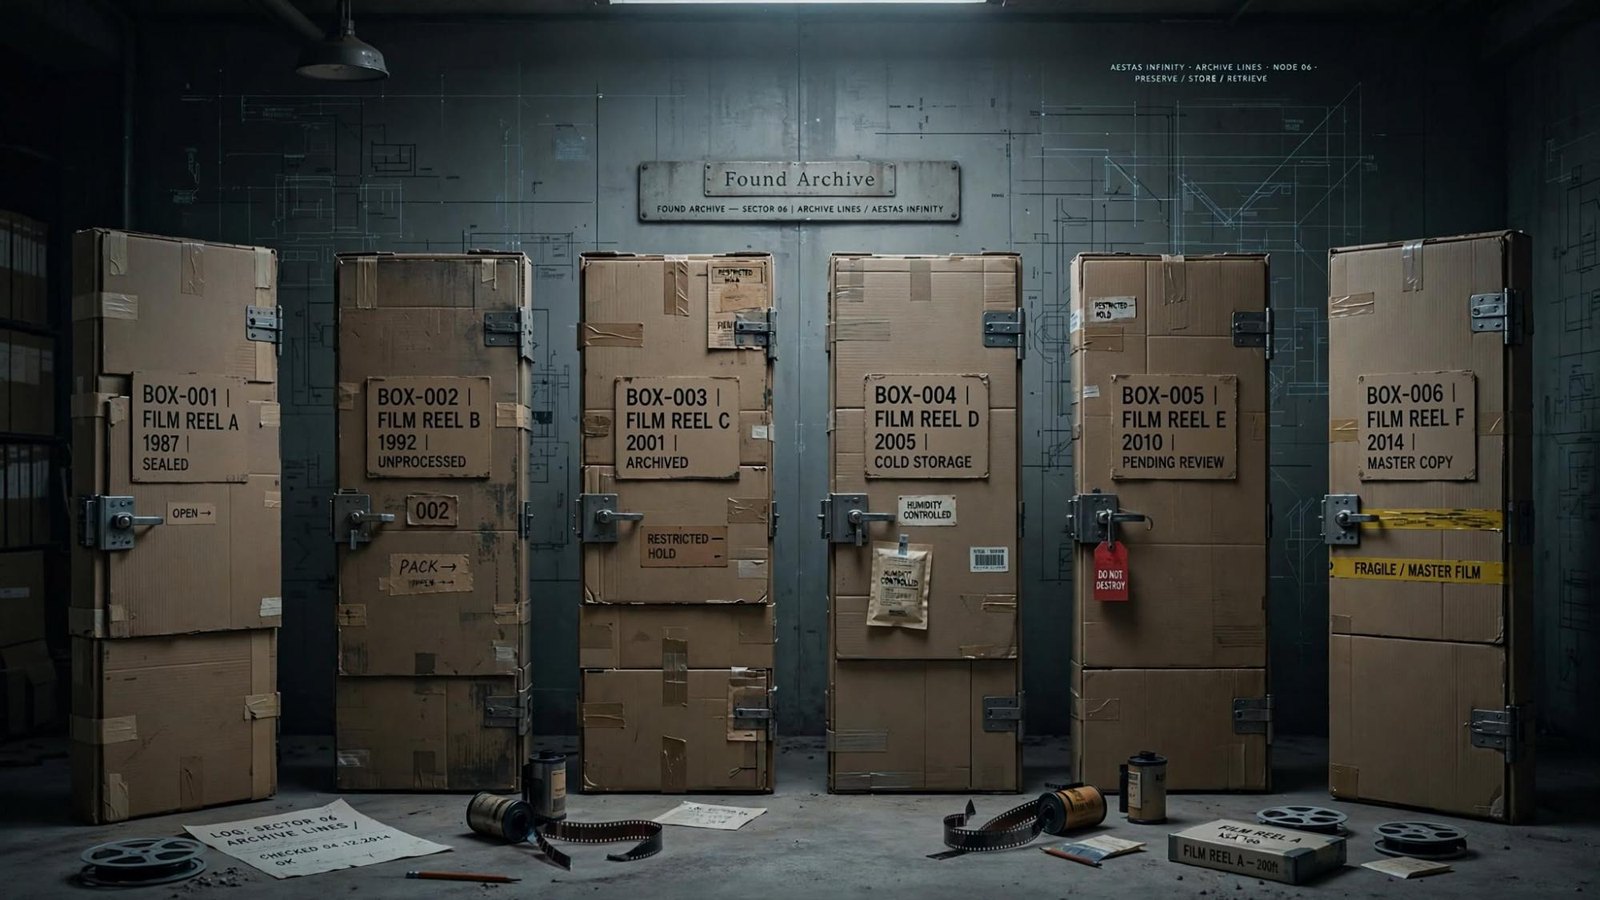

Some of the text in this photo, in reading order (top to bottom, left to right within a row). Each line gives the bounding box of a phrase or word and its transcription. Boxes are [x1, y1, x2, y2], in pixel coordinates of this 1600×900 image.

[725, 172, 875, 187] Found Archive
[657, 205, 687, 213] FOUND
[690, 205, 725, 213] ARCHIVE
[742, 205, 775, 213] SECTOR
[778, 205, 788, 213] 06
[798, 205, 834, 213] ARCHIVE
[837, 205, 861, 213] LINES
[872, 205, 903, 213] AESTAS
[906, 205, 944, 213] INFINITY
[143, 384, 217, 406] BOX-001
[378, 388, 458, 406] BOX-002
[626, 388, 707, 406] BOX-003
[875, 386, 956, 404] BOX-004
[1122, 386, 1204, 405] BOX-005
[1367, 384, 1443, 404] BOX-006
[143, 410, 239, 430] FILM REEL A
[378, 412, 480, 428] FILM REEL B
[626, 412, 730, 429] FILM REEL C
[875, 410, 979, 427] FILM REEL D
[1122, 410, 1226, 428] FILM REEL E
[1367, 408, 1464, 429] FILM REEL F
[143, 434, 179, 452] 1987
[378, 434, 416, 451] 1992
[626, 434, 664, 450] 2001
[875, 433, 916, 450] 2005
[1122, 434, 1162, 451] 2010
[1367, 434, 1404, 452] 2014
[143, 458, 189, 471] SEALED
[378, 456, 466, 468] UNPROCESSED
[626, 456, 688, 469] ARCHIVED
[875, 456, 972, 468] COLD STORAGE
[1122, 456, 1224, 469] PENDING REVIEW
[1367, 456, 1453, 470] MASTER COPY
[173, 508, 198, 518] OPEN
[416, 502, 448, 519] 002
[907, 501, 942, 510] HUMIDITY
[904, 510, 951, 519] CONTROLLED
[648, 534, 708, 544] RESTRICTED
[648, 548, 676, 559] HOLD
[399, 559, 438, 575] PACK
[1098, 570, 1123, 579] DO NOT
[1355, 562, 1396, 576] FRAGILE
[1408, 565, 1451, 578] MASTER
[1455, 566, 1481, 579] FILM
[1096, 581, 1125, 590] DESTROY
[210, 814, 338, 839] LOG: SECTOR 06
[1218, 825, 1252, 834] FILM
[1254, 830, 1286, 841] REEL
[227, 829, 298, 847] ARCHIVE
[302, 823, 349, 834] LINES
[259, 846, 319, 861] CHECKED
[1183, 844, 1206, 861] FILM
[1209, 849, 1233, 865] REEL
[1237, 854, 1245, 867] A
[1257, 859, 1279, 874] 200ft
[275, 858, 296, 866] OK
